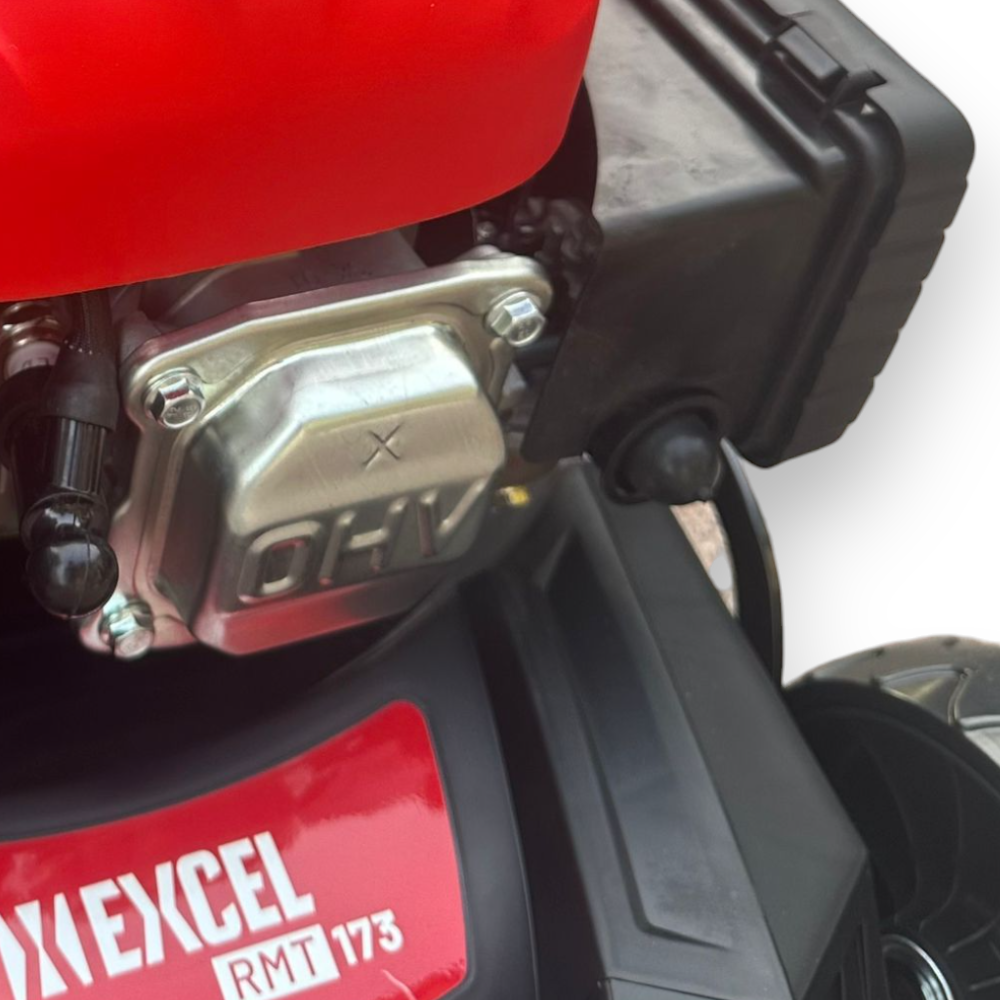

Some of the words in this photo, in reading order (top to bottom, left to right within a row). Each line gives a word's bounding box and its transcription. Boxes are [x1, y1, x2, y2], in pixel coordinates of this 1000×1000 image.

[238, 475, 493, 605] OHV
[226, 934, 317, 1000] RMT
[330, 907, 405, 967] 173
